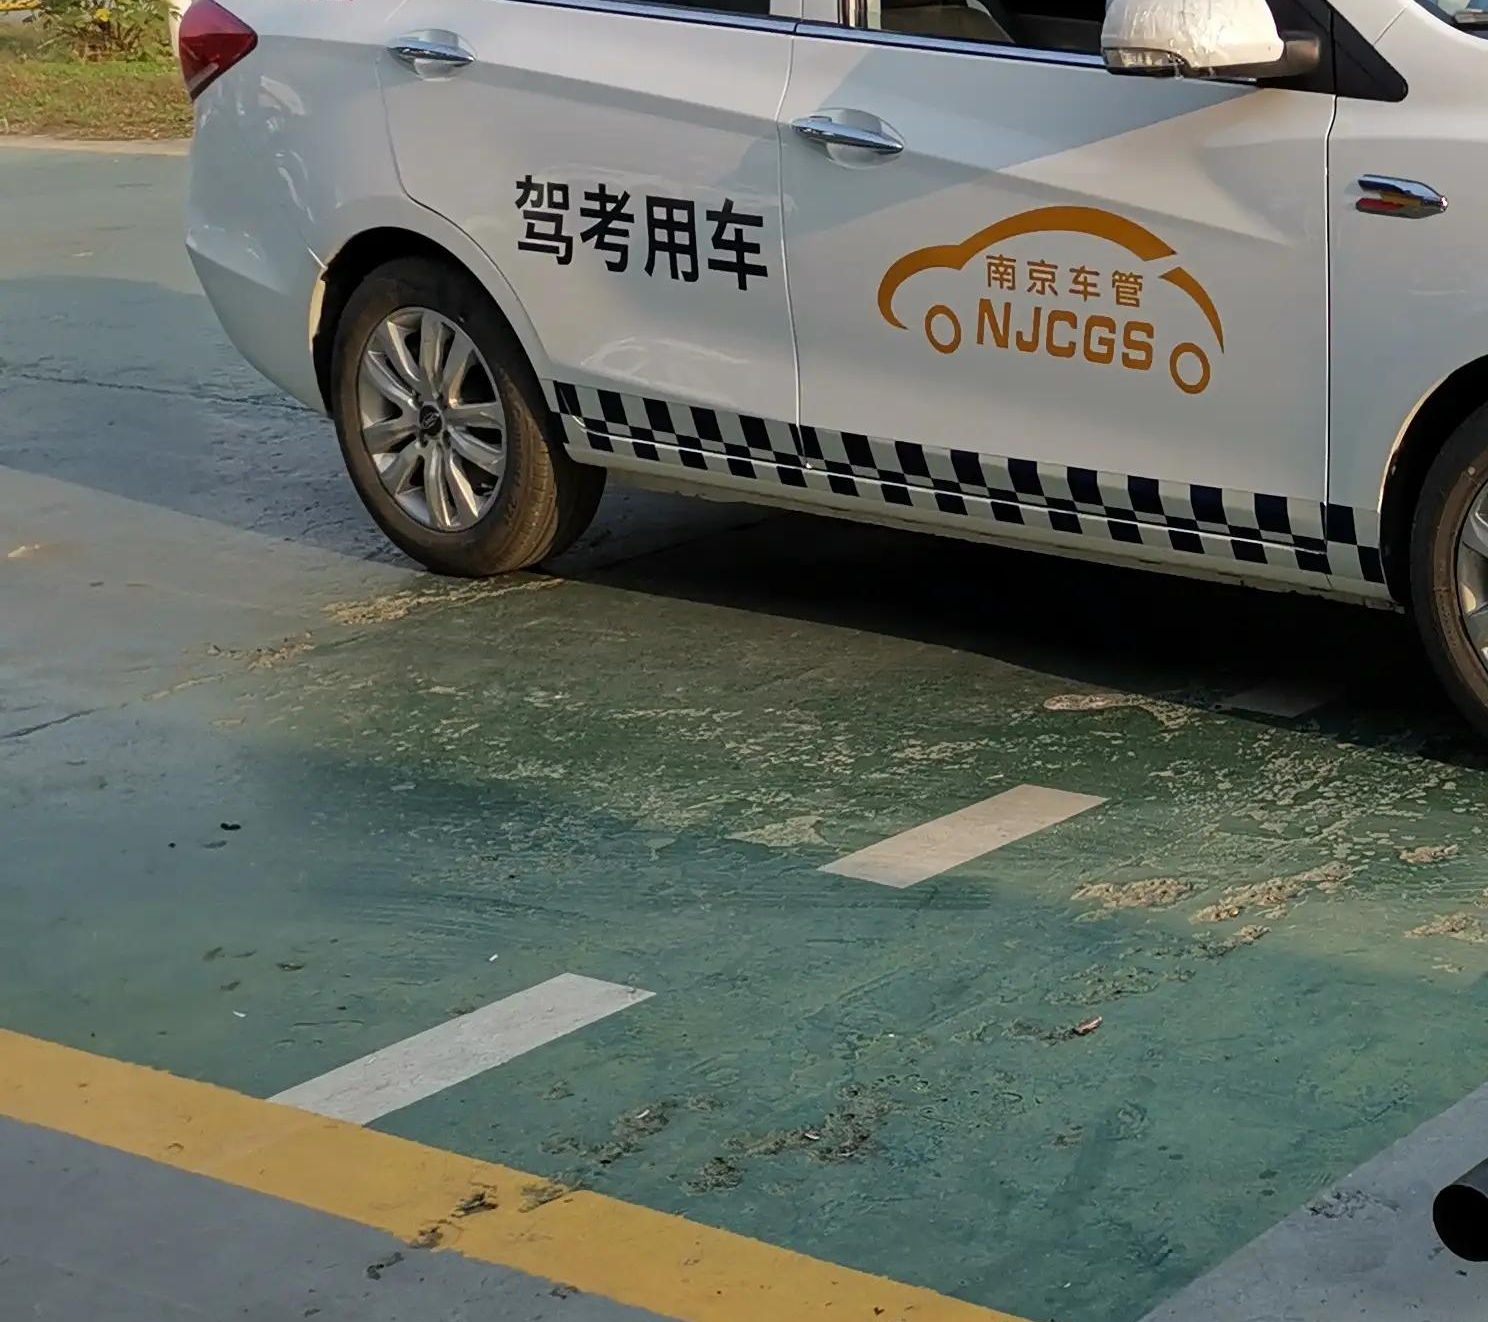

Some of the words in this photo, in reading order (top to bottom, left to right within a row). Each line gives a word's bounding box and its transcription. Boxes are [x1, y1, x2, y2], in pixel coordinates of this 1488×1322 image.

[514, 174, 769, 291] 驾考用车
[985, 254, 1144, 308] 南京车管
[976, 298, 1155, 371] NJCGS
